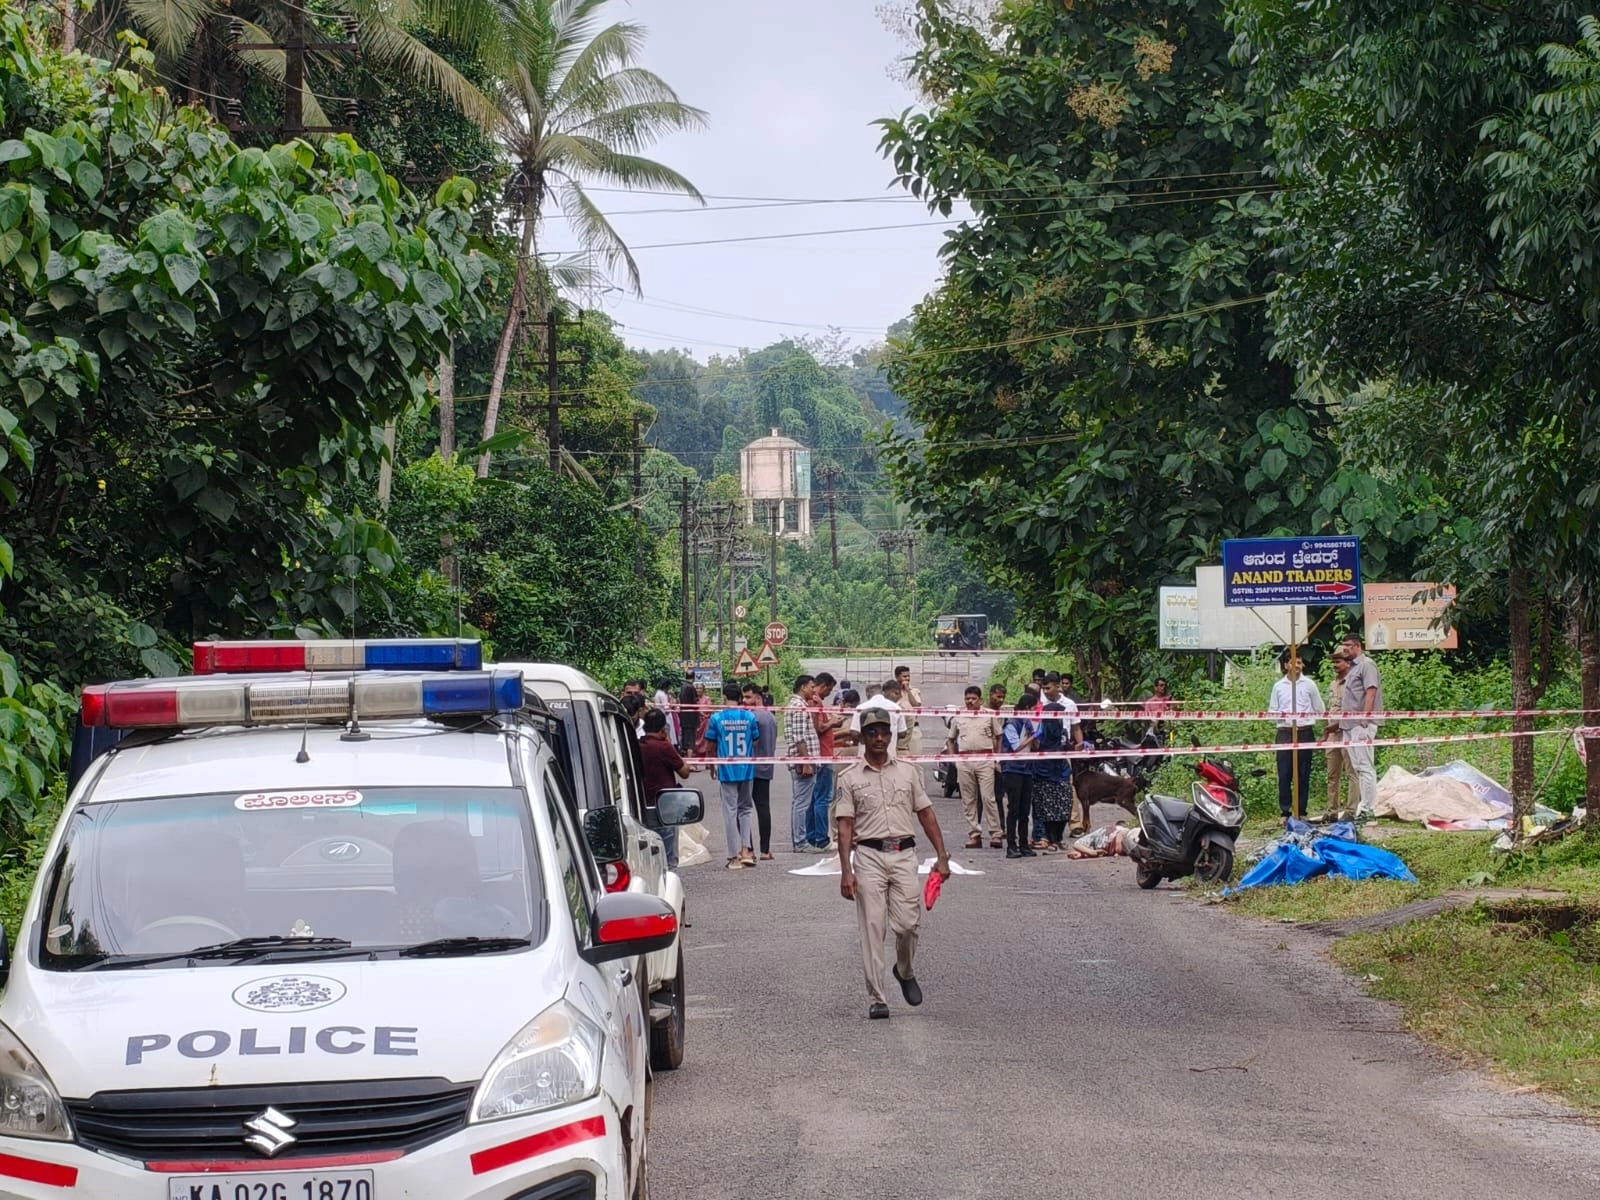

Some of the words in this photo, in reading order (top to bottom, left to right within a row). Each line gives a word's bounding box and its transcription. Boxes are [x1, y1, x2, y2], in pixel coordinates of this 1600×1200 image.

[1231, 570, 1283, 584] ANAND
[1286, 569, 1352, 583] TRADERS
[766, 628, 786, 639] STOP
[725, 732, 748, 756] 15
[244, 790, 357, 808] ಪೊಲೀಸ್
[125, 1025, 419, 1066] POLICE
[235, 1182, 287, 1200] 02G
[303, 1178, 371, 1200] 1870
